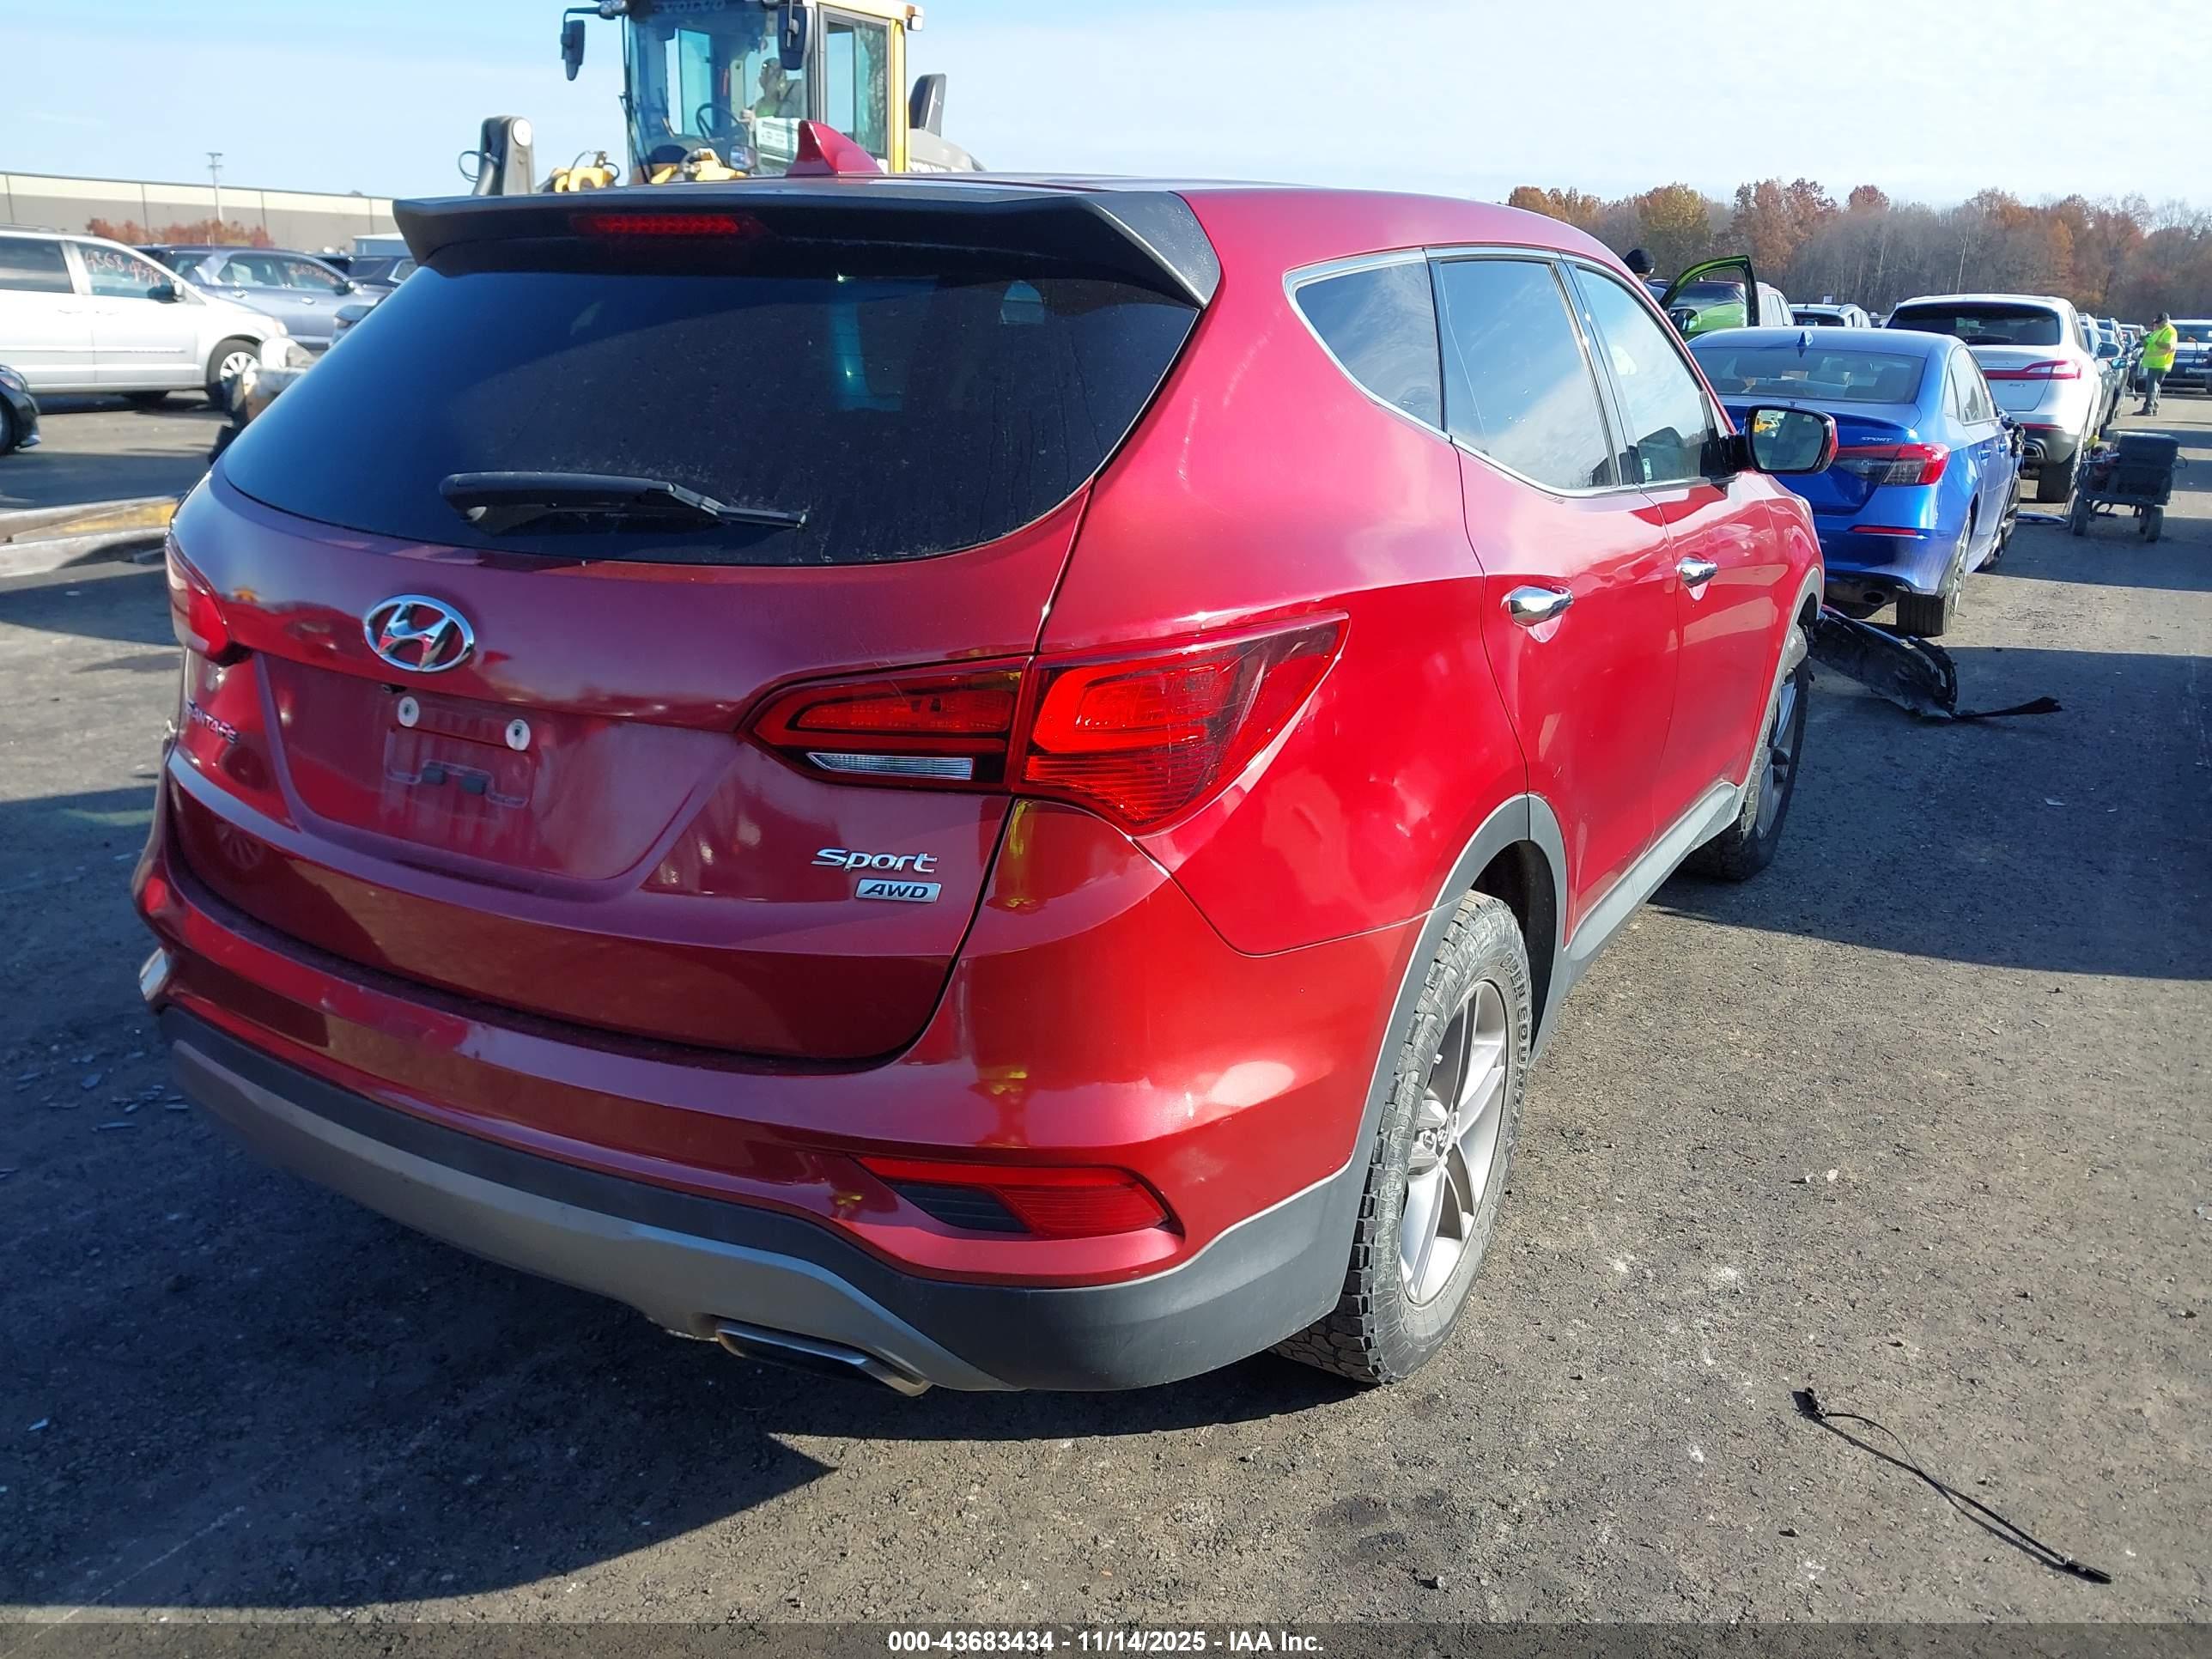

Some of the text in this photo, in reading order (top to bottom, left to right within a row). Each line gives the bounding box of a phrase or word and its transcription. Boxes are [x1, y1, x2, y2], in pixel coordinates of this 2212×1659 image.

[810, 848, 939, 872] Sport
[863, 883, 929, 899] AWD
[1500, 951, 1526, 1001] OPEN
